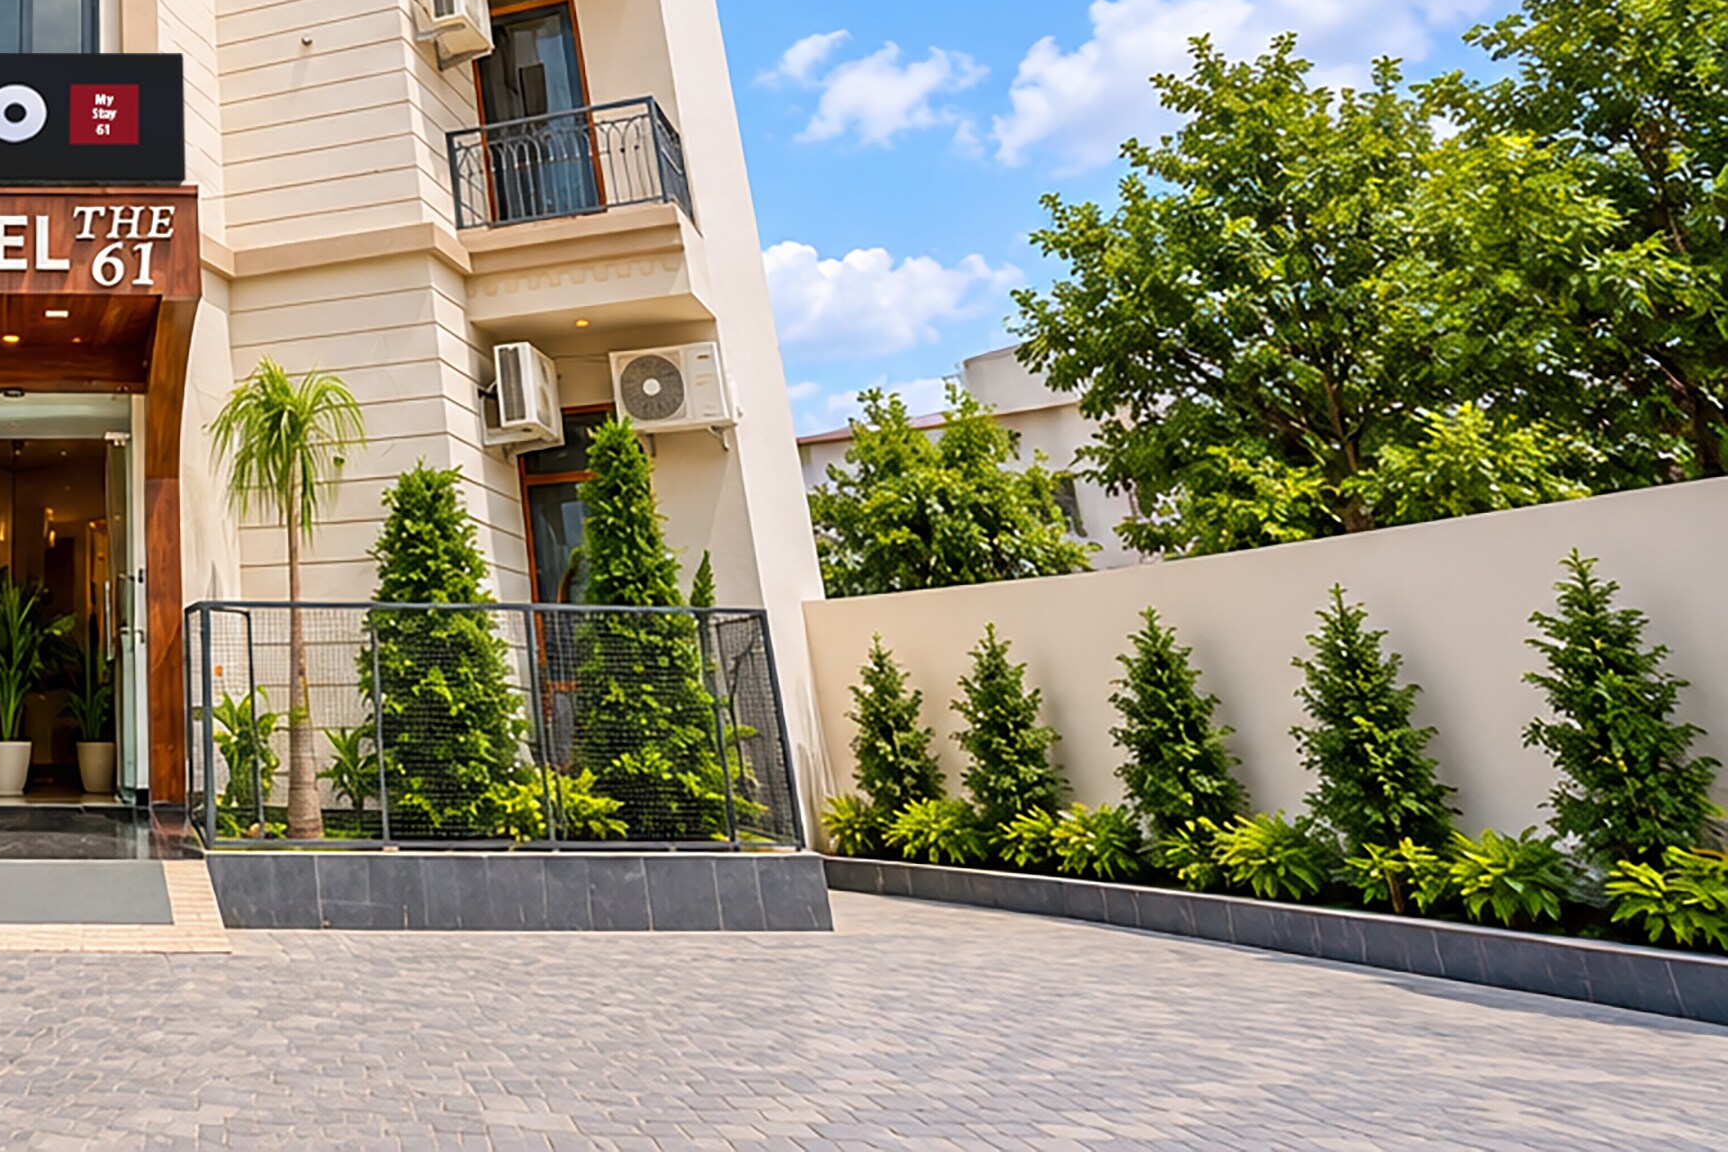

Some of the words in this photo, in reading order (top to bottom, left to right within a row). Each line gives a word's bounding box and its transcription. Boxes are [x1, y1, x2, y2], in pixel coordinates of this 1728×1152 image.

[95, 93, 114, 107] My
[92, 108, 117, 121] Stay
[95, 123, 110, 135] 61
[73, 205, 176, 240] THE
[91, 241, 156, 287] 61
